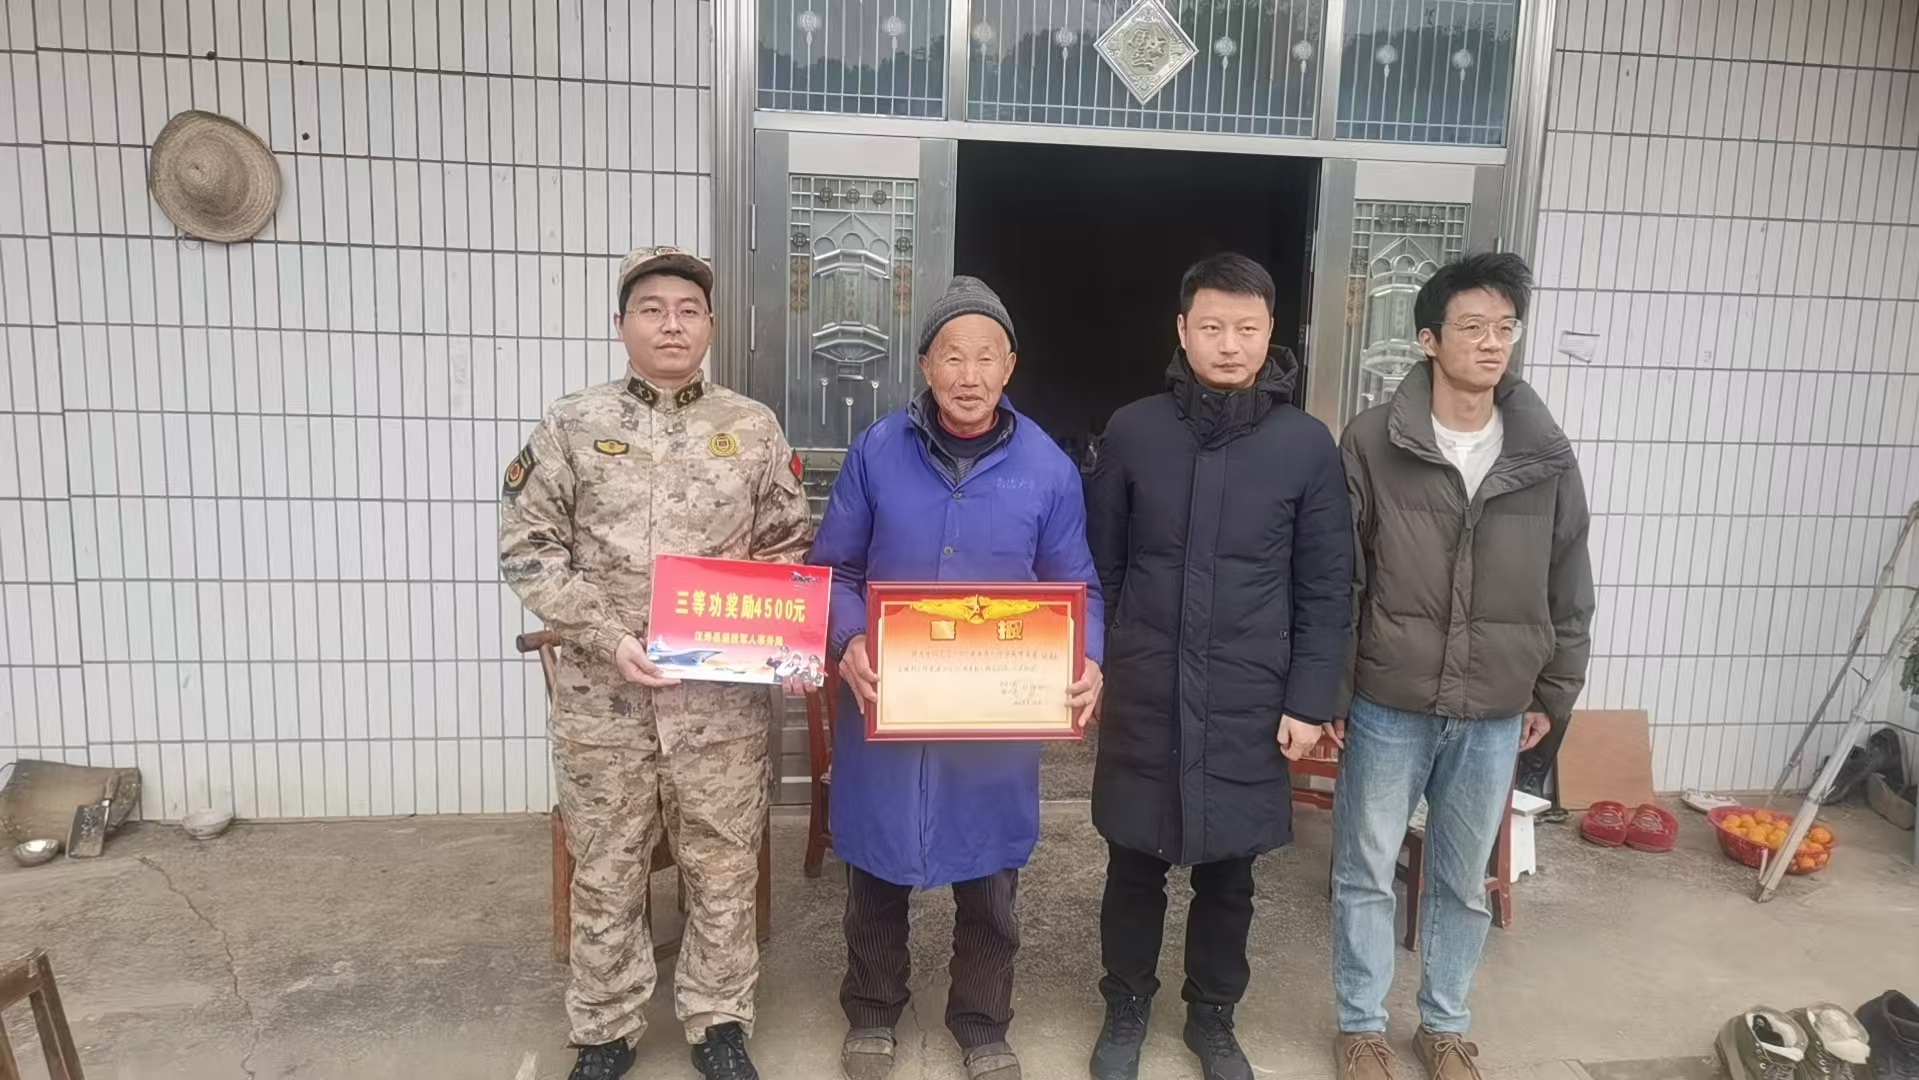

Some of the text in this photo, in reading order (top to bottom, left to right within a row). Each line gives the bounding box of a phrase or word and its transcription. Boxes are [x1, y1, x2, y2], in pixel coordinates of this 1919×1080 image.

[675, 589, 806, 623] 三等功奖励4500元
[930, 619, 1023, 641] 报
